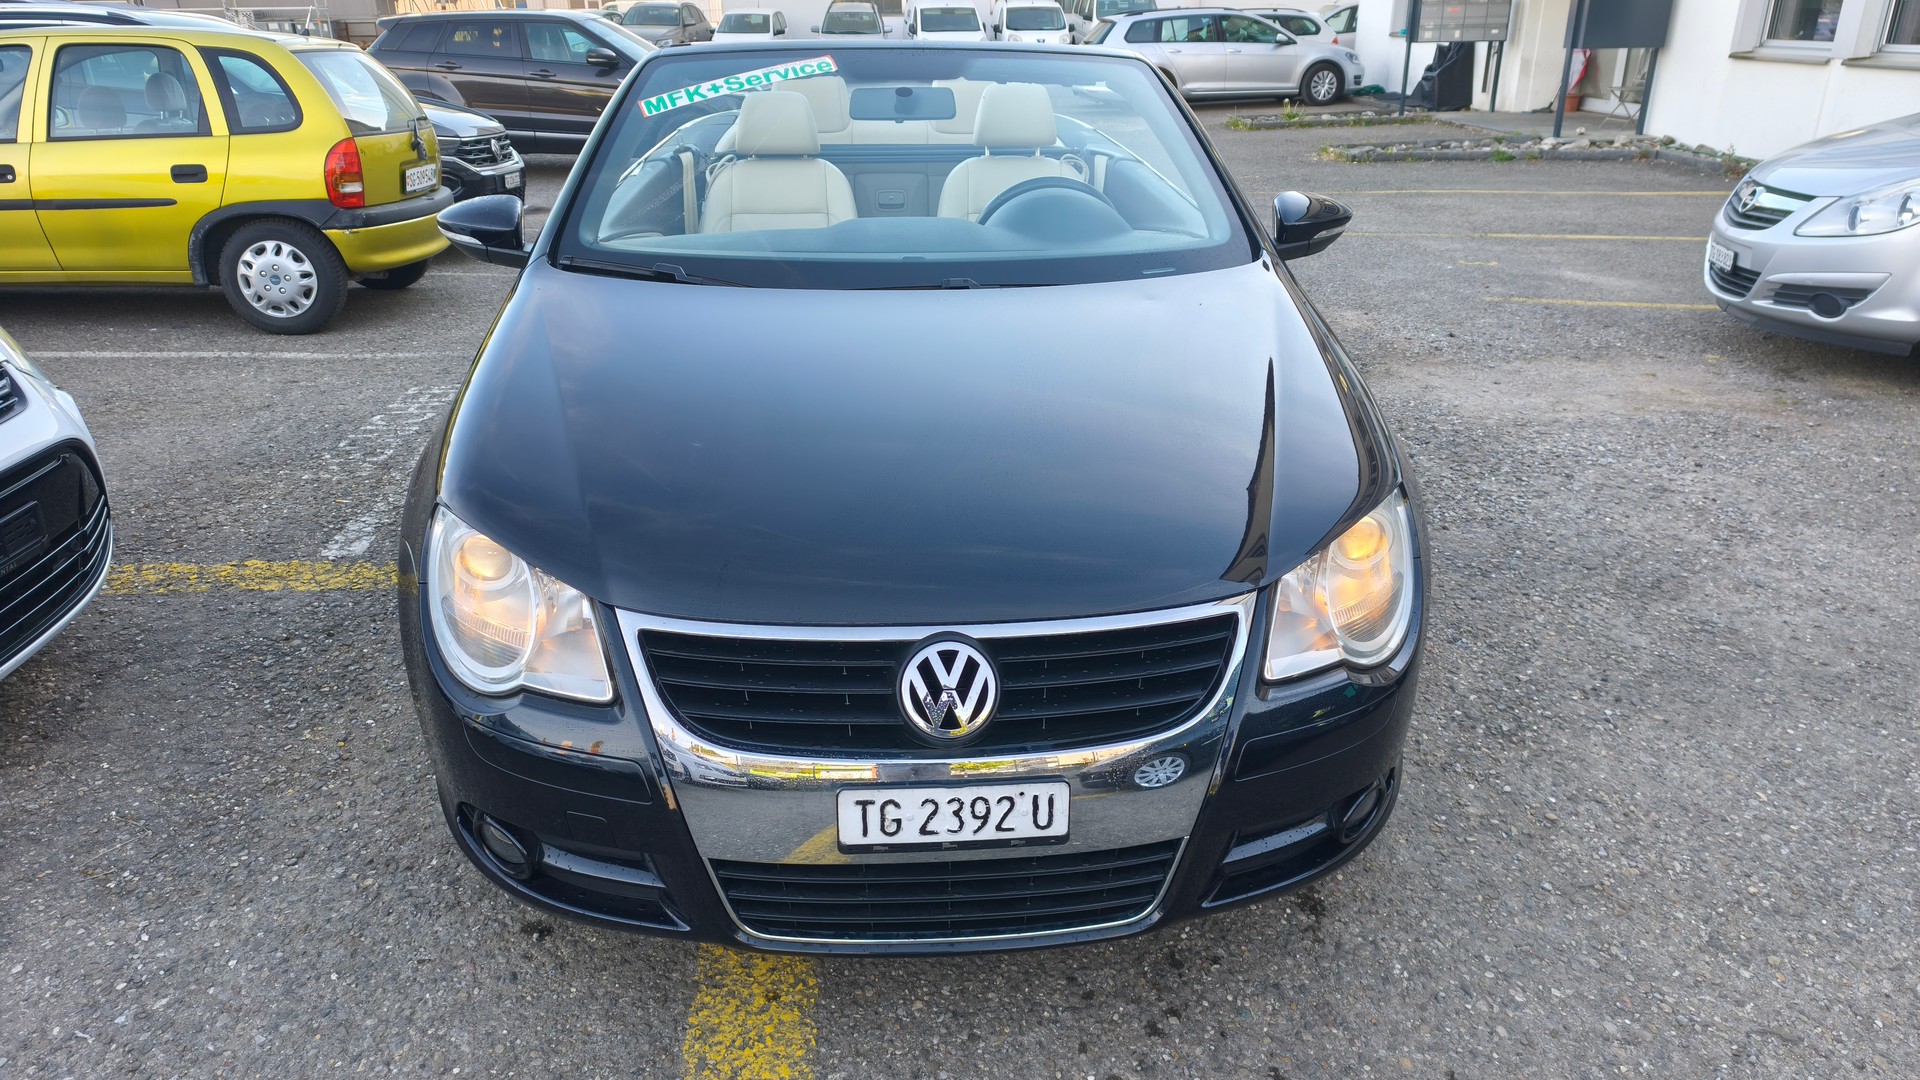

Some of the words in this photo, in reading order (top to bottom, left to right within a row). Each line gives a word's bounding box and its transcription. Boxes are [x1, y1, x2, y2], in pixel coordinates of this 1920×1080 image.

[642, 60, 834, 115] MFK+Service
[854, 799, 902, 838] TG
[918, 795, 1016, 836] 2392
[1031, 793, 1055, 831] U
